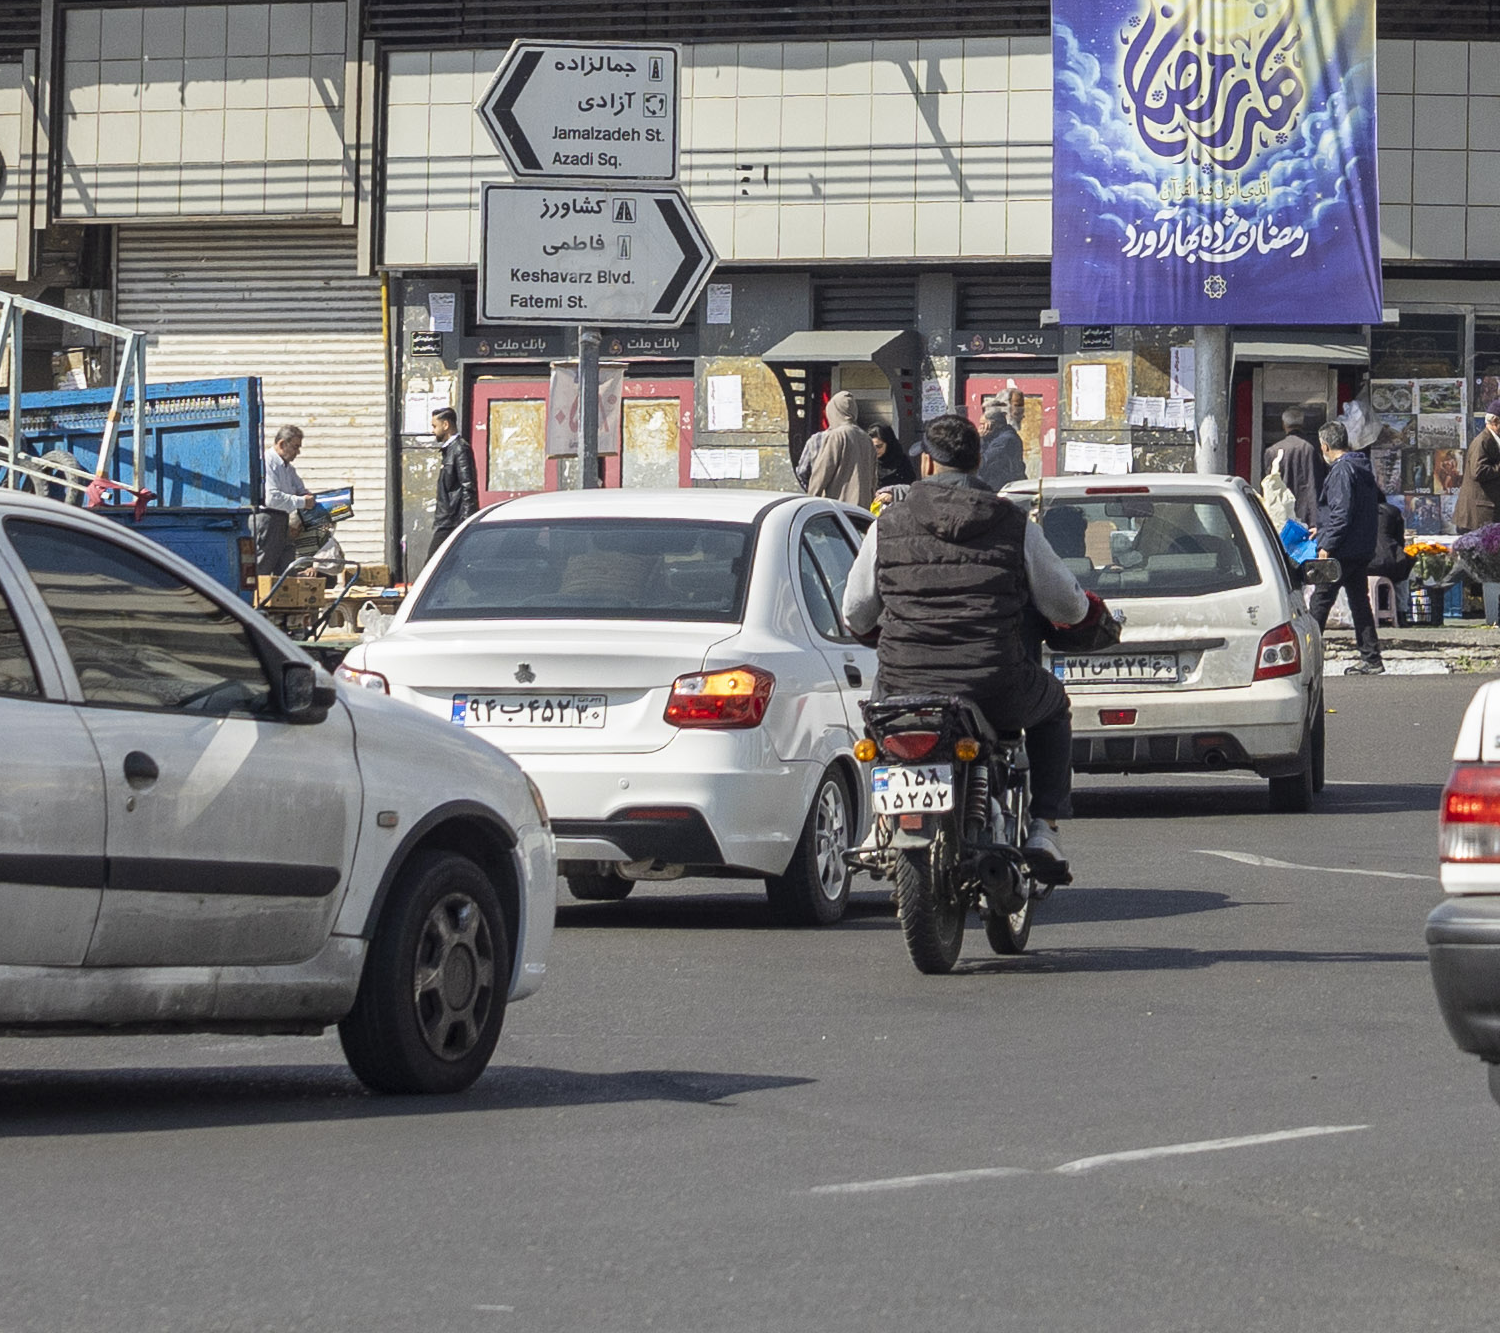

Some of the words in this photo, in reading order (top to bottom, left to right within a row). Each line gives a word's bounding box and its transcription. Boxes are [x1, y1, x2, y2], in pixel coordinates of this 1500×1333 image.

[554, 55, 637, 77] جمالزاده
[578, 91, 636, 116] آزادی
[552, 126, 640, 142] Jamalzadeh
[645, 129, 665, 142] St.
[552, 152, 593, 166] Azadi
[597, 153, 622, 169] Sq.
[540, 197, 606, 219] کشاورز
[542, 234, 605, 256] فاطمی
[1198, 214, 1309, 263] رمضان
[510, 268, 592, 283] Keshavarz
[597, 270, 635, 284] Blvd.
[510, 294, 562, 308] Fatemi
[567, 295, 588, 309] St.
